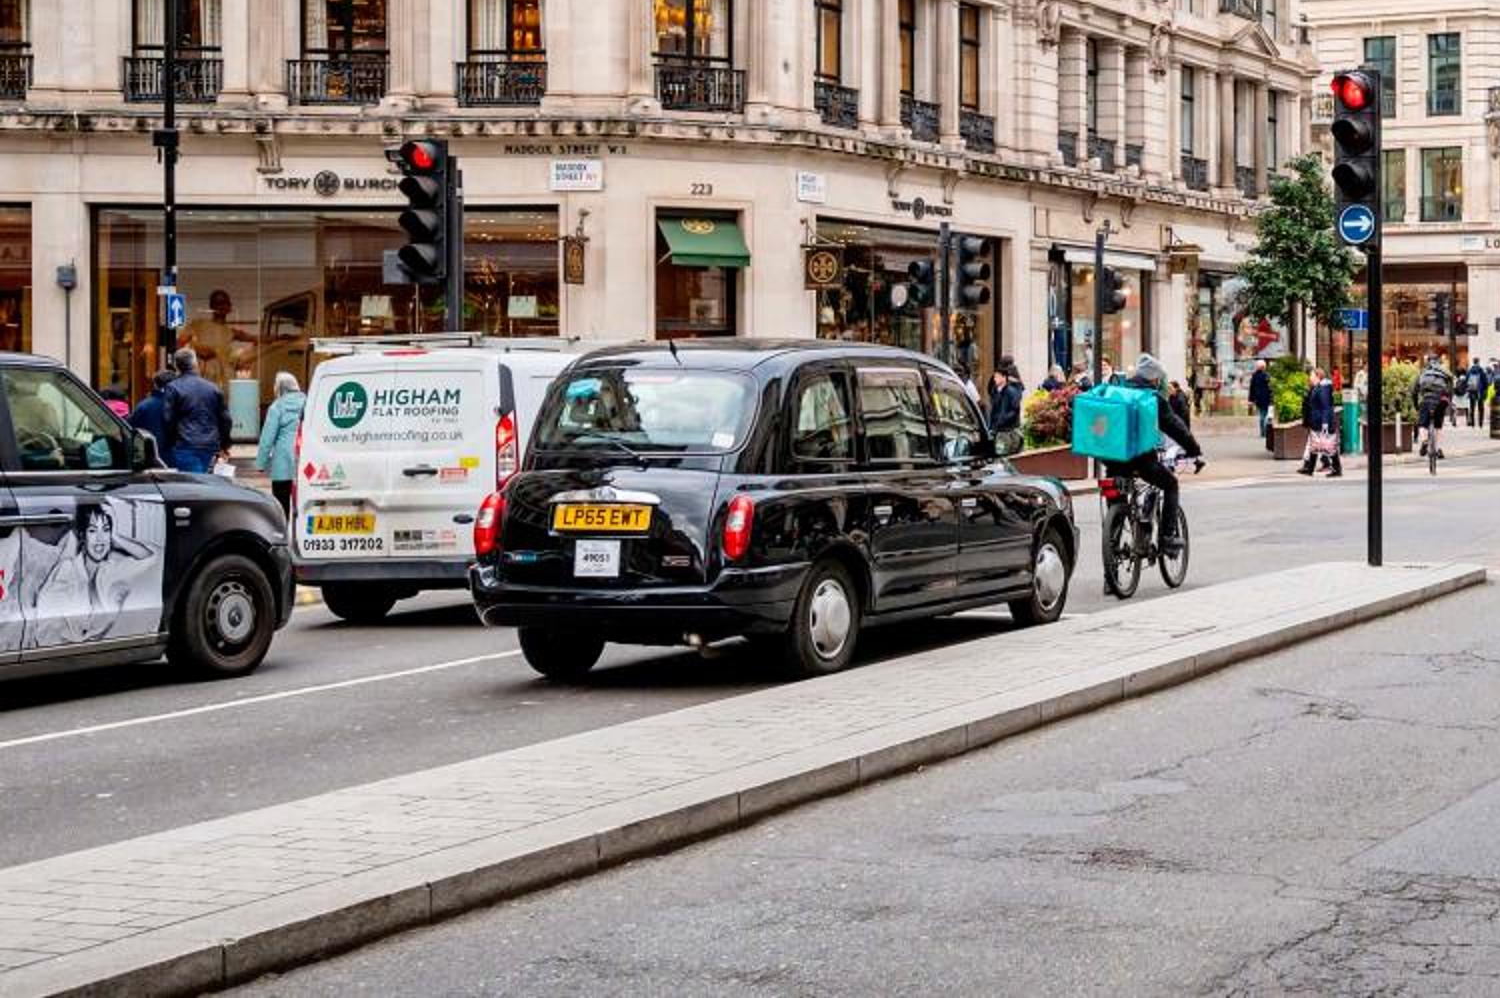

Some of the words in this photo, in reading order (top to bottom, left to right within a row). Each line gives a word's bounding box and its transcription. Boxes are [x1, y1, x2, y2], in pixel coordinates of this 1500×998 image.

[504, 144, 552, 155] MADDOX
[559, 144, 600, 154] STREET
[264, 178, 308, 190] TORY
[691, 183, 713, 196] 223
[373, 389, 461, 405] HIGHAM
[372, 407, 400, 417] FLAT
[404, 406, 459, 417] ROOFING
[322, 430, 463, 443] www.highamroofing.co.uk
[563, 509, 605, 526] LP65
[609, 509, 642, 525] EWT
[304, 539, 335, 551] 01933
[340, 538, 383, 551] 317202
